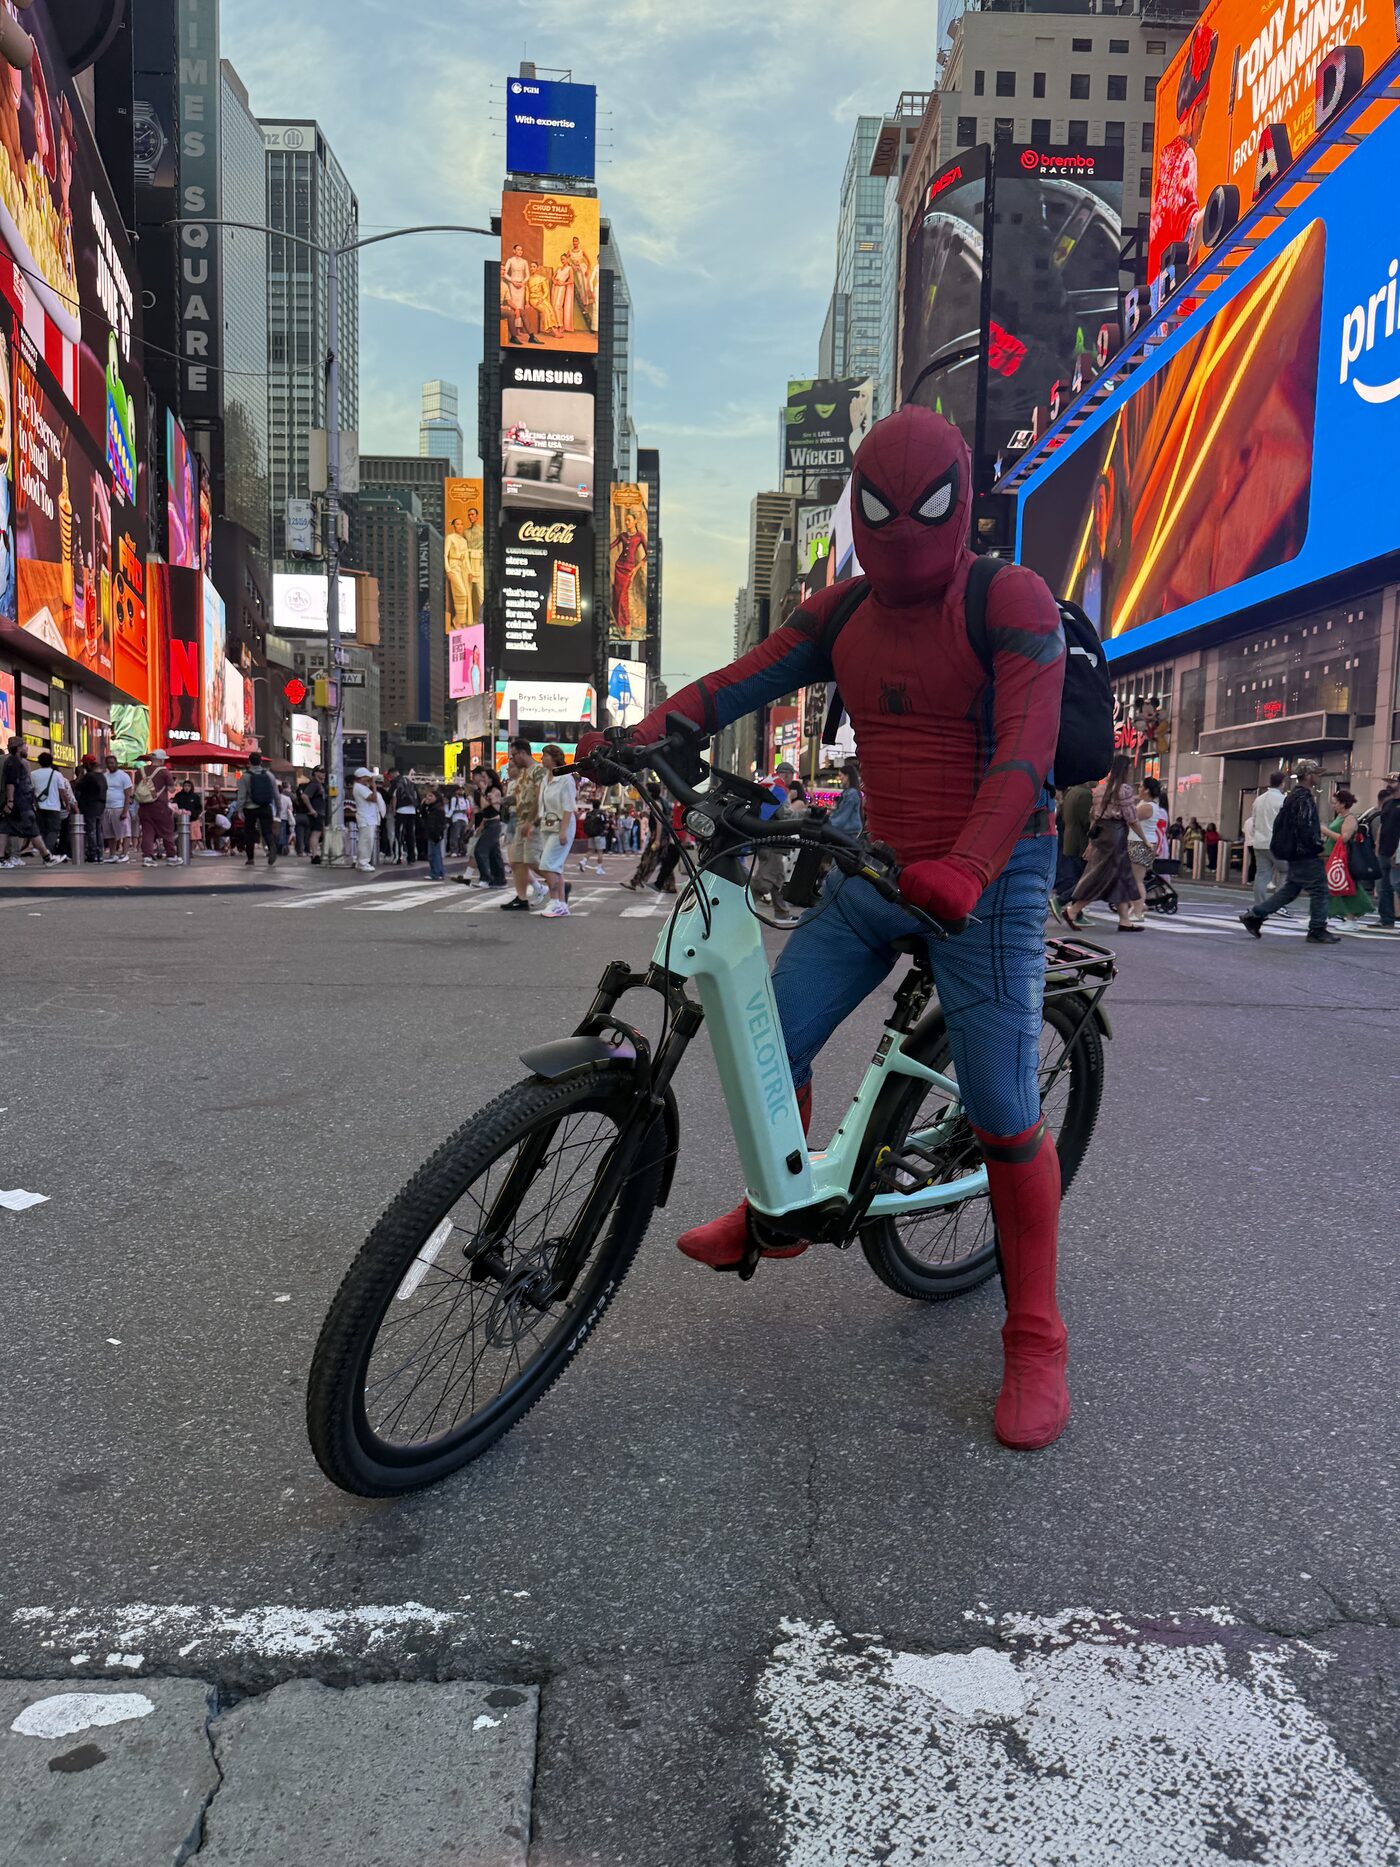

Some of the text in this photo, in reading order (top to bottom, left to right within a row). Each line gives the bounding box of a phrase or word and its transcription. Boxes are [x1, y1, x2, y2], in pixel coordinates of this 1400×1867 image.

[1237, 0, 1288, 101] TONY
[1251, 0, 1346, 124] WINNING
[514, 115, 576, 129] With expertise
[1039, 153, 1095, 168] brembo
[1040, 166, 1095, 175] RACING
[551, 205, 568, 213] THAI
[182, 186, 209, 392] SQUARE
[1339, 258, 1400, 385] pri
[514, 367, 583, 385] SAMSUNG
[18, 377, 61, 461] He Deserves
[534, 440, 562, 449] THE USA
[547, 433, 574, 442] ACROSS
[19, 420, 49, 481] to Smell
[20, 459, 54, 521] Good Too
[518, 520, 577, 544] Coca-Cola
[505, 556, 528, 566] stores
[505, 567, 522, 576] near
[505, 598, 540, 610] small step
[518, 693, 569, 704] Bryn Stickley
[168, 729, 191, 740] MAY
[53, 742, 75, 763] SEPHORA
[745, 990, 790, 1126] VELOTRIC
[567, 1279, 616, 1352] KENDA
